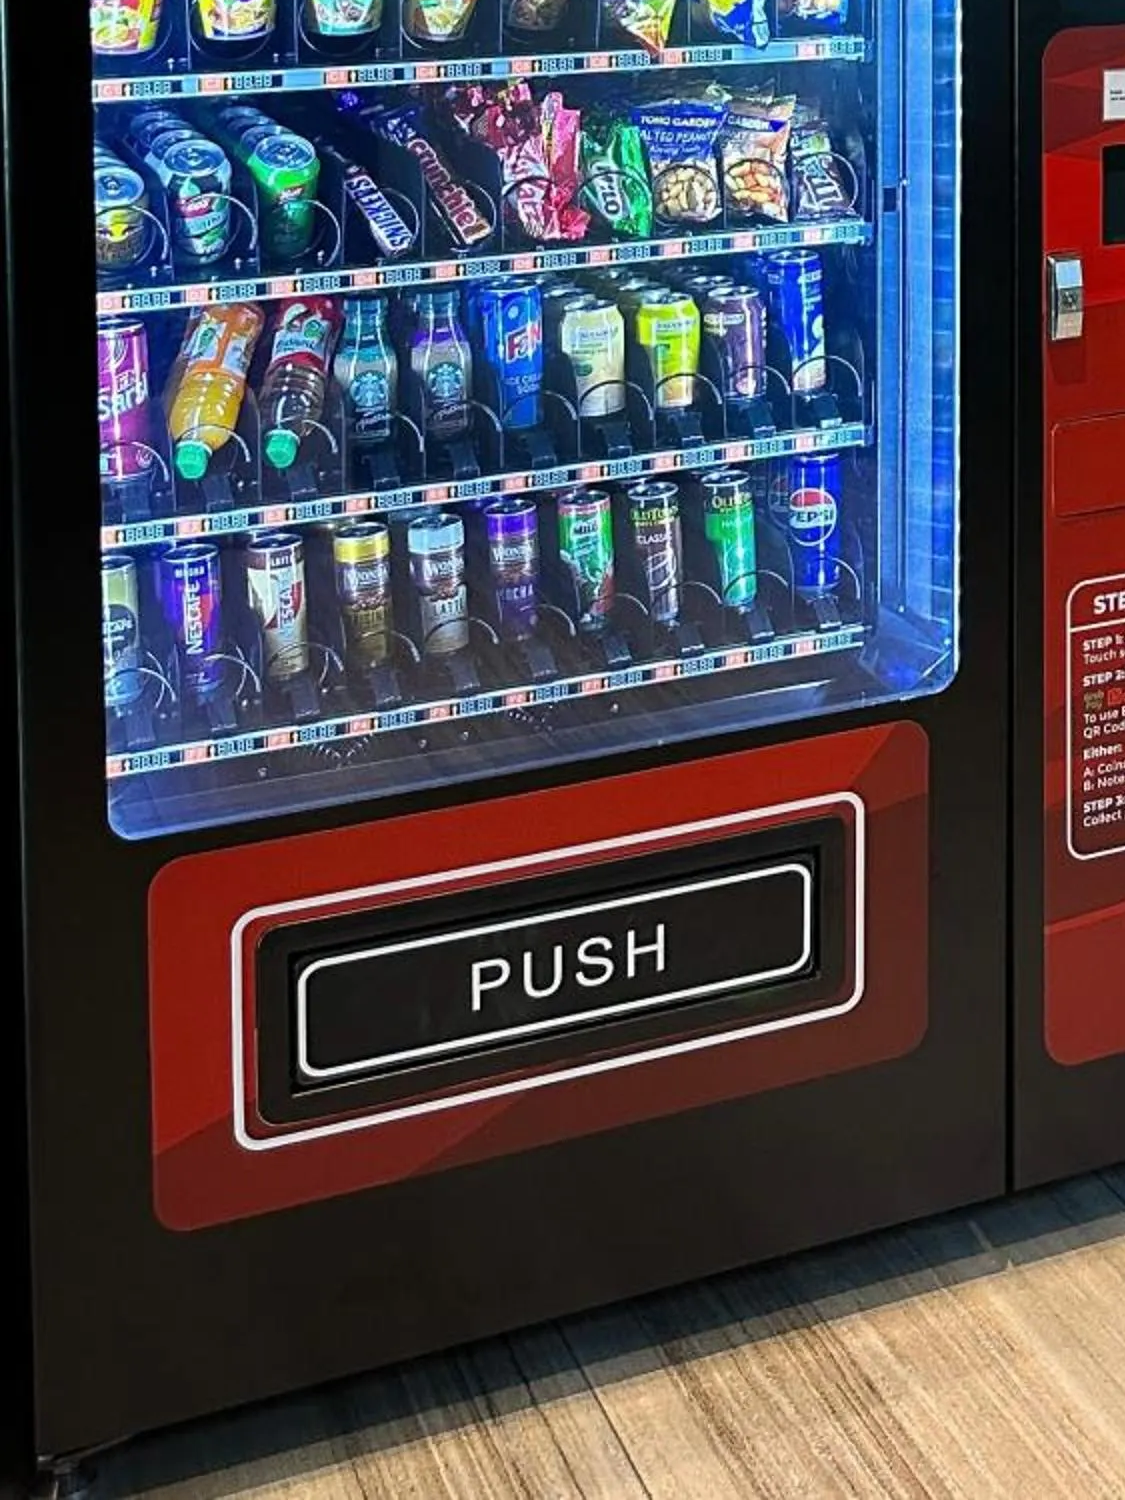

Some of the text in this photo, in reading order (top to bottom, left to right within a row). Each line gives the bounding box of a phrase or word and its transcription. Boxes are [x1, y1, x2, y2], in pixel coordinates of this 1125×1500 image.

[1082, 636, 1113, 652] STEP
[1083, 650, 1117, 665] Touch
[1082, 671, 1113, 687] STEP
[1084, 712, 1096, 724] To
[1099, 709, 1118, 721] use
[1083, 727, 1101, 740] QR
[1082, 797, 1113, 814] STEP
[1083, 811, 1122, 827] Collect
[471, 923, 666, 1011] PUSH
